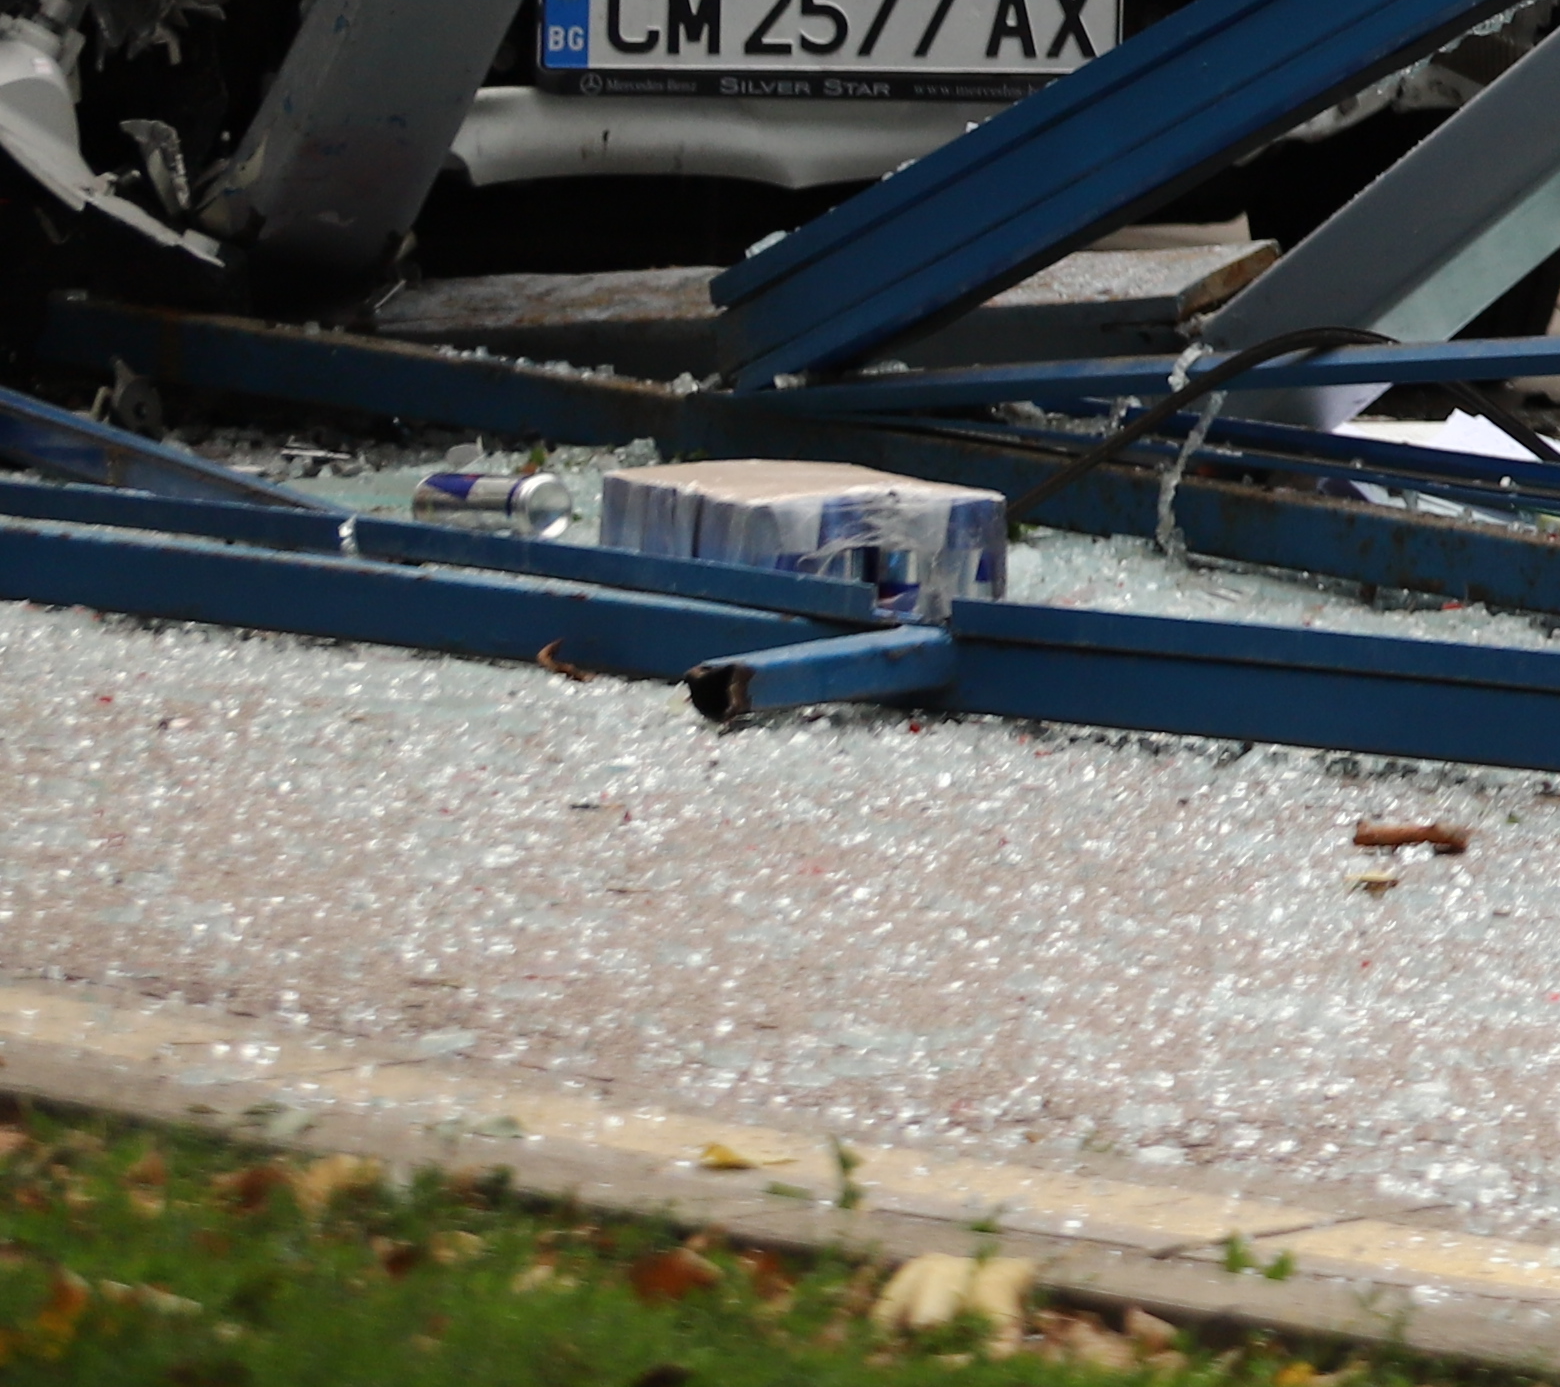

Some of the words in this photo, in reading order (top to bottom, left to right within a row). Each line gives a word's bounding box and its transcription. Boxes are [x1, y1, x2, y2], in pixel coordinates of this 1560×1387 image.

[547, 26, 585, 51] BG
[719, 77, 812, 95] SILVER
[822, 77, 891, 96] STAR
